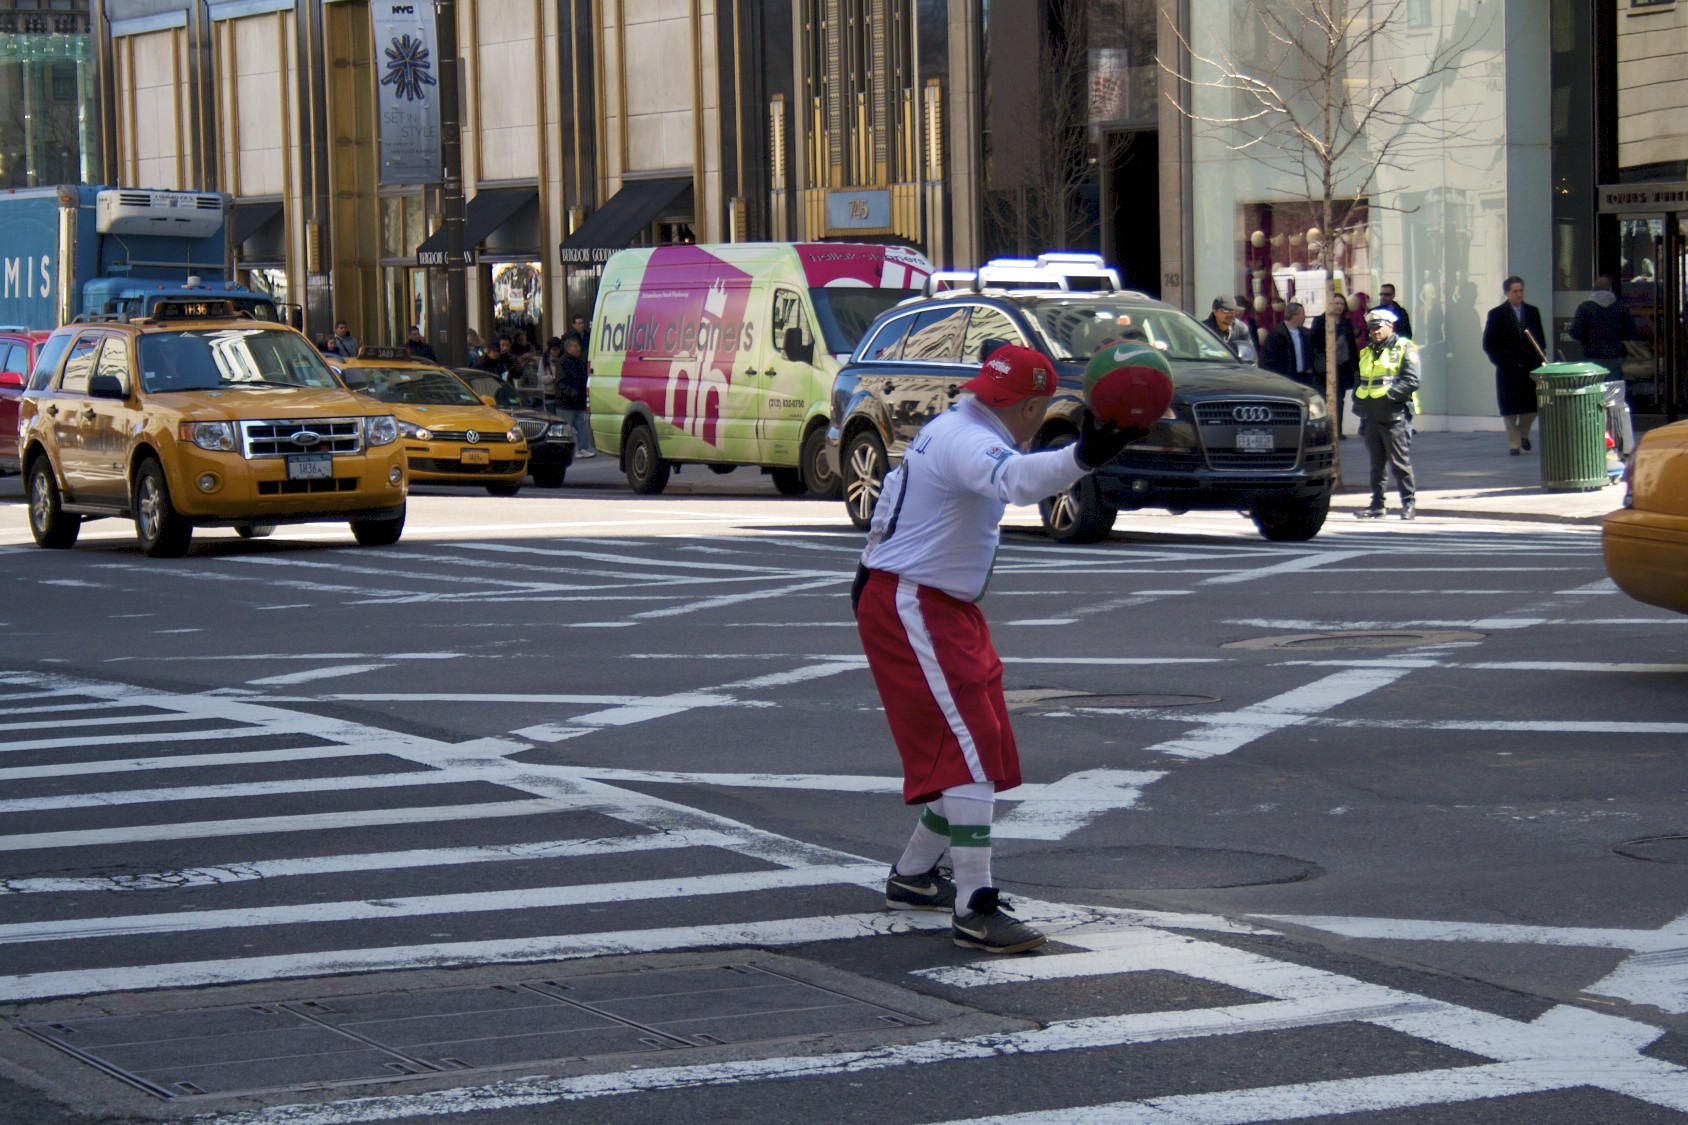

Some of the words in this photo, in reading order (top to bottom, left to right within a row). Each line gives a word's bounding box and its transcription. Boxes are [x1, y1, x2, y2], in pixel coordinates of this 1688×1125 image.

[392, 5, 414, 14] NYC
[383, 111, 404, 124] SET
[406, 113, 417, 123] IN
[401, 125, 437, 138] STYLE
[848, 199, 869, 220] 745
[1164, 273, 1180, 288] 743
[600, 313, 659, 353] hallak
[664, 312, 754, 353] cleaners
[768, 398, 781, 409] (212)
